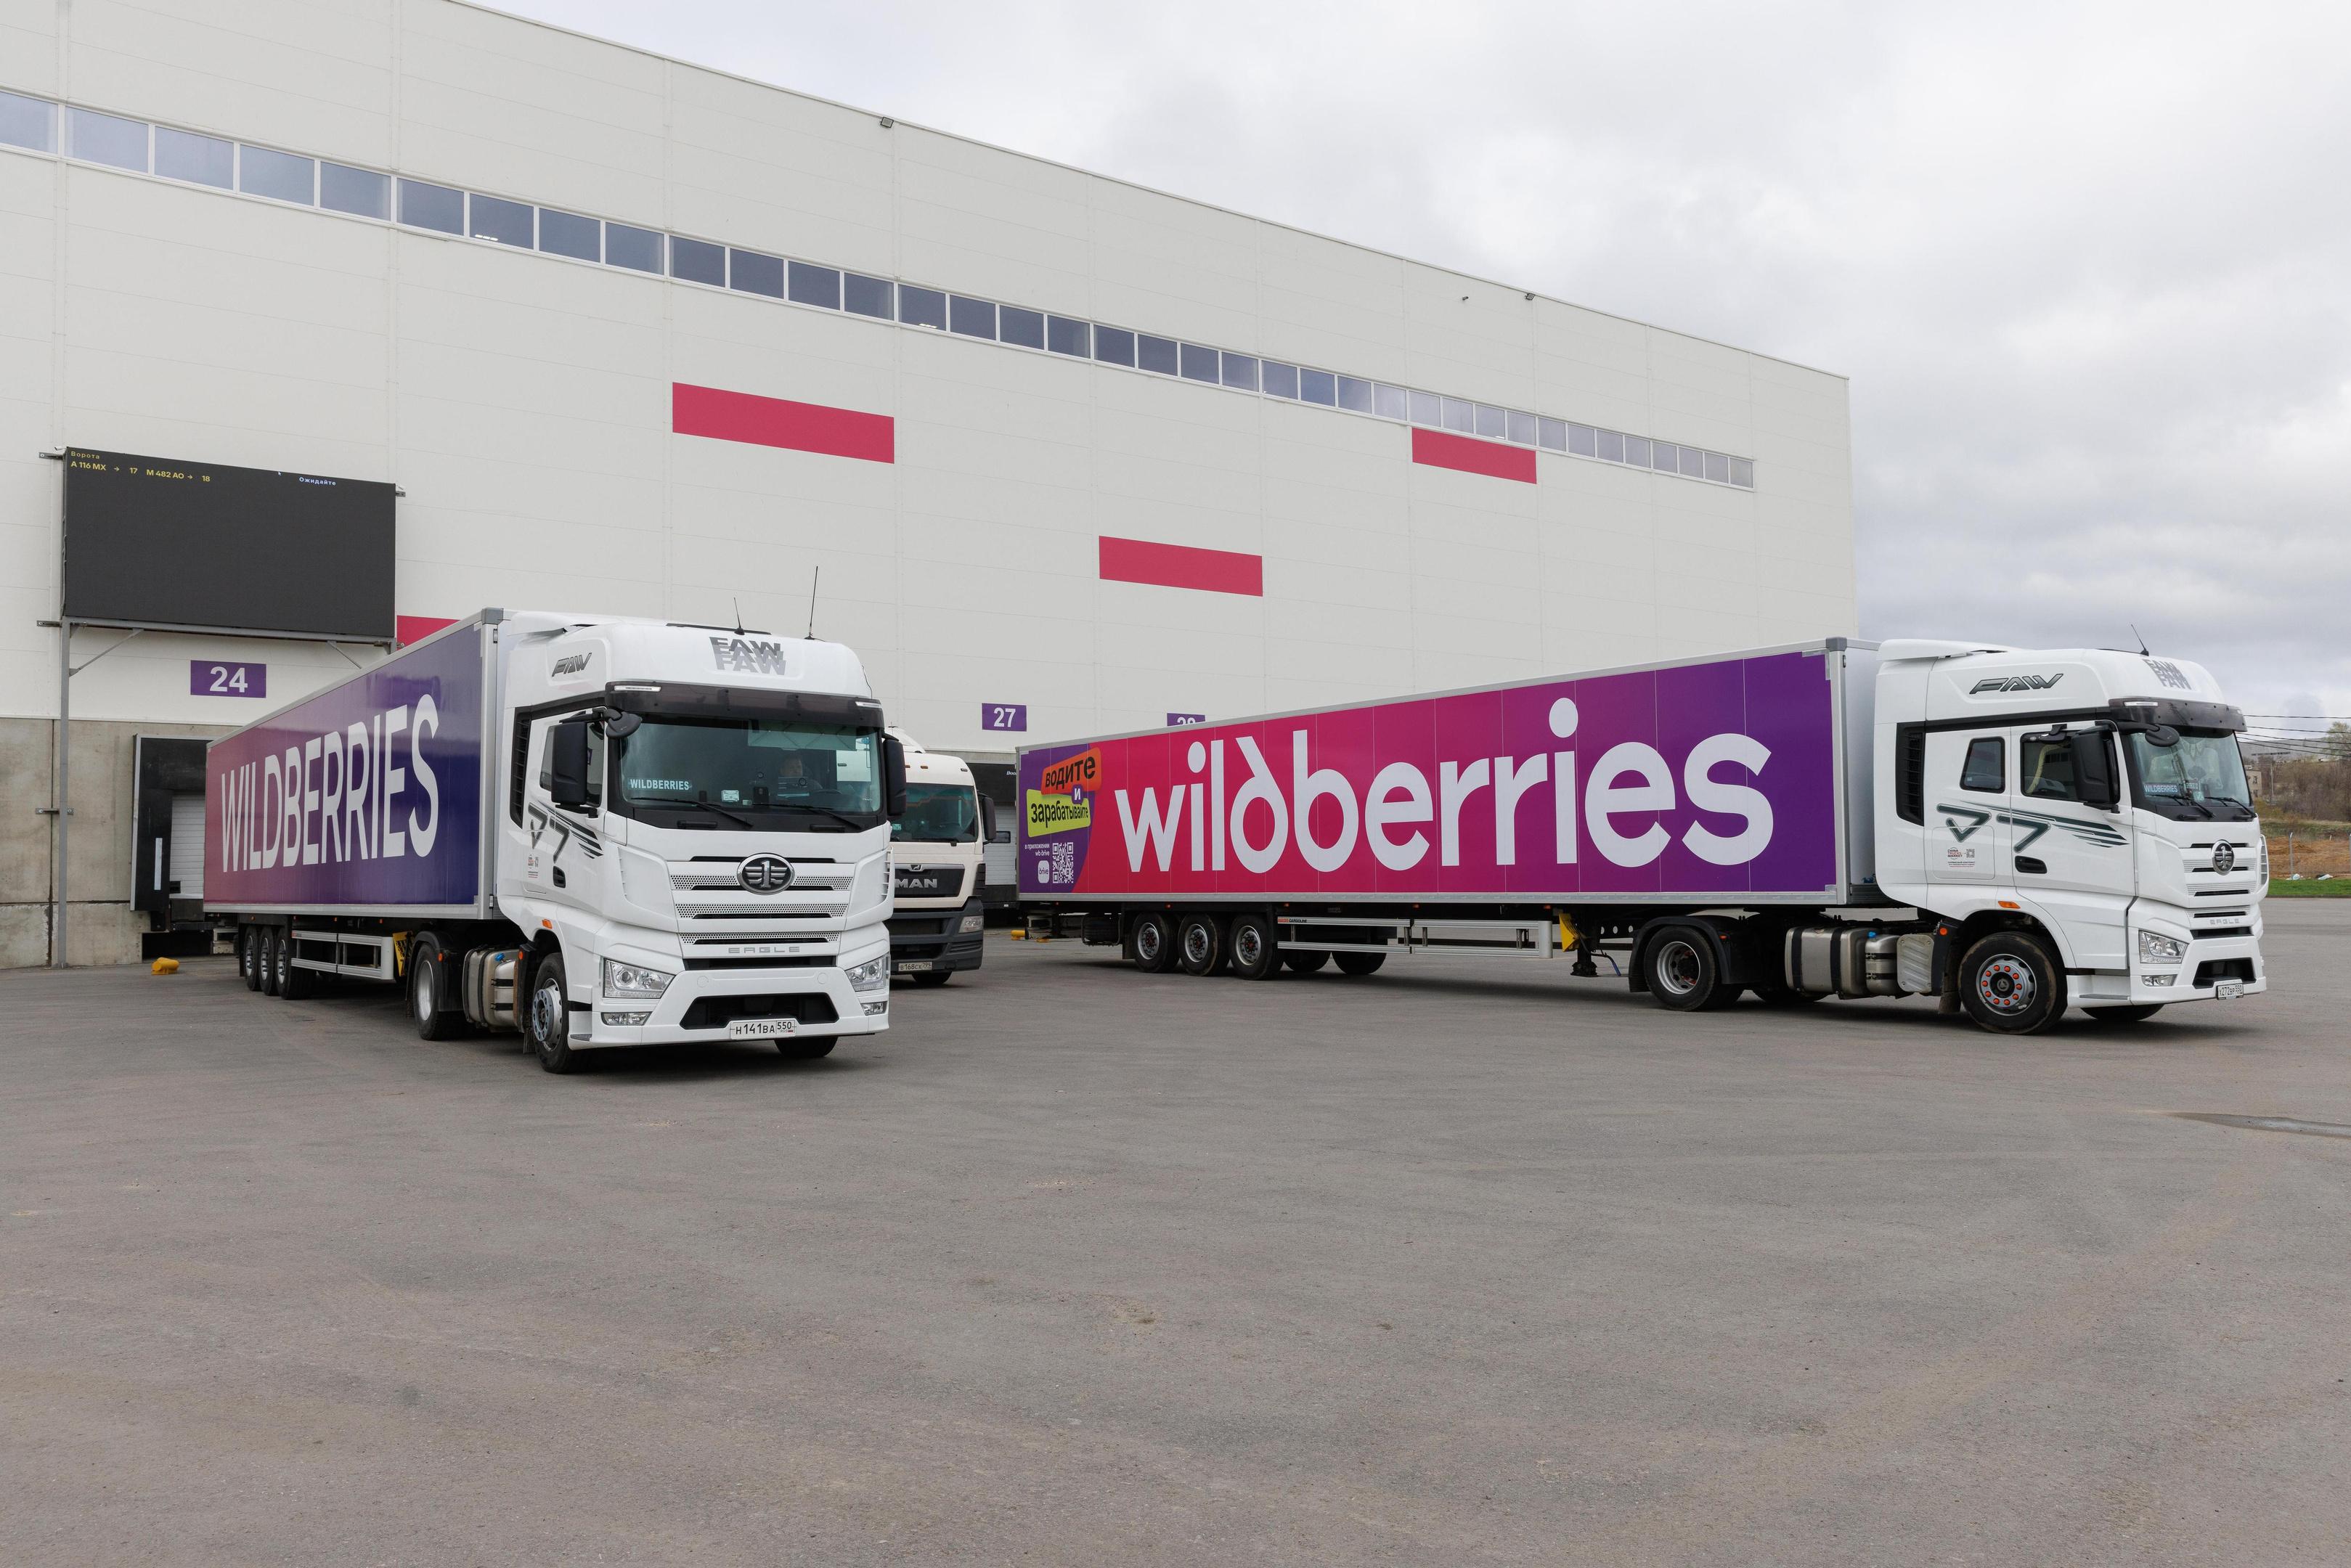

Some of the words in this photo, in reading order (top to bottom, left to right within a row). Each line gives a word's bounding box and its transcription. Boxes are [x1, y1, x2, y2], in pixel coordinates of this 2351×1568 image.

[71, 451, 100, 460] Ворота
[299, 476, 336, 486] Ожидайте
[551, 652, 592, 677] FAW
[210, 666, 248, 693] 24
[1969, 673, 2063, 694] FAW
[993, 707, 1016, 727] 27
[221, 694, 439, 873] WILDBERRIES
[1046, 756, 1096, 790] водите
[630, 778, 689, 791] WILDBERRIES
[1115, 697, 1774, 873] wildberries
[895, 878, 937, 889] MAN
